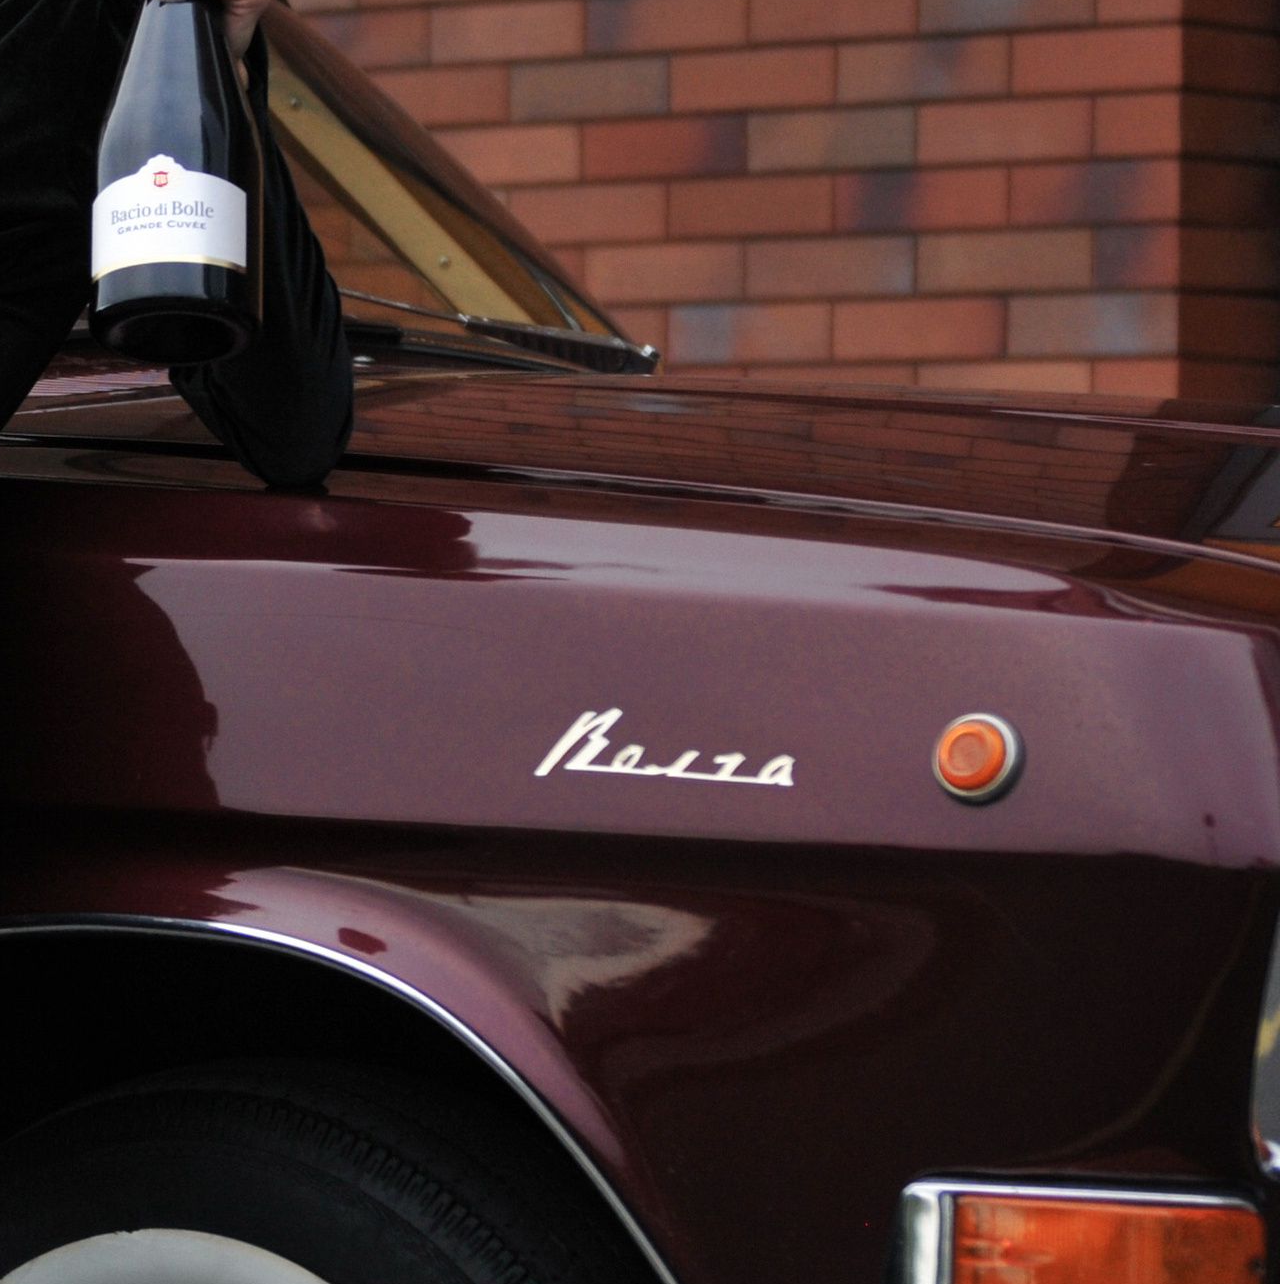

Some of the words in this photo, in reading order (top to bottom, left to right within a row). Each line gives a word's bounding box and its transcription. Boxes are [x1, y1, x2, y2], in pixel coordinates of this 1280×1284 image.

[111, 203, 152, 225] Bacio
[154, 202, 168, 216] di
[172, 200, 215, 219] Bolle
[117, 221, 162, 235] GRANDE
